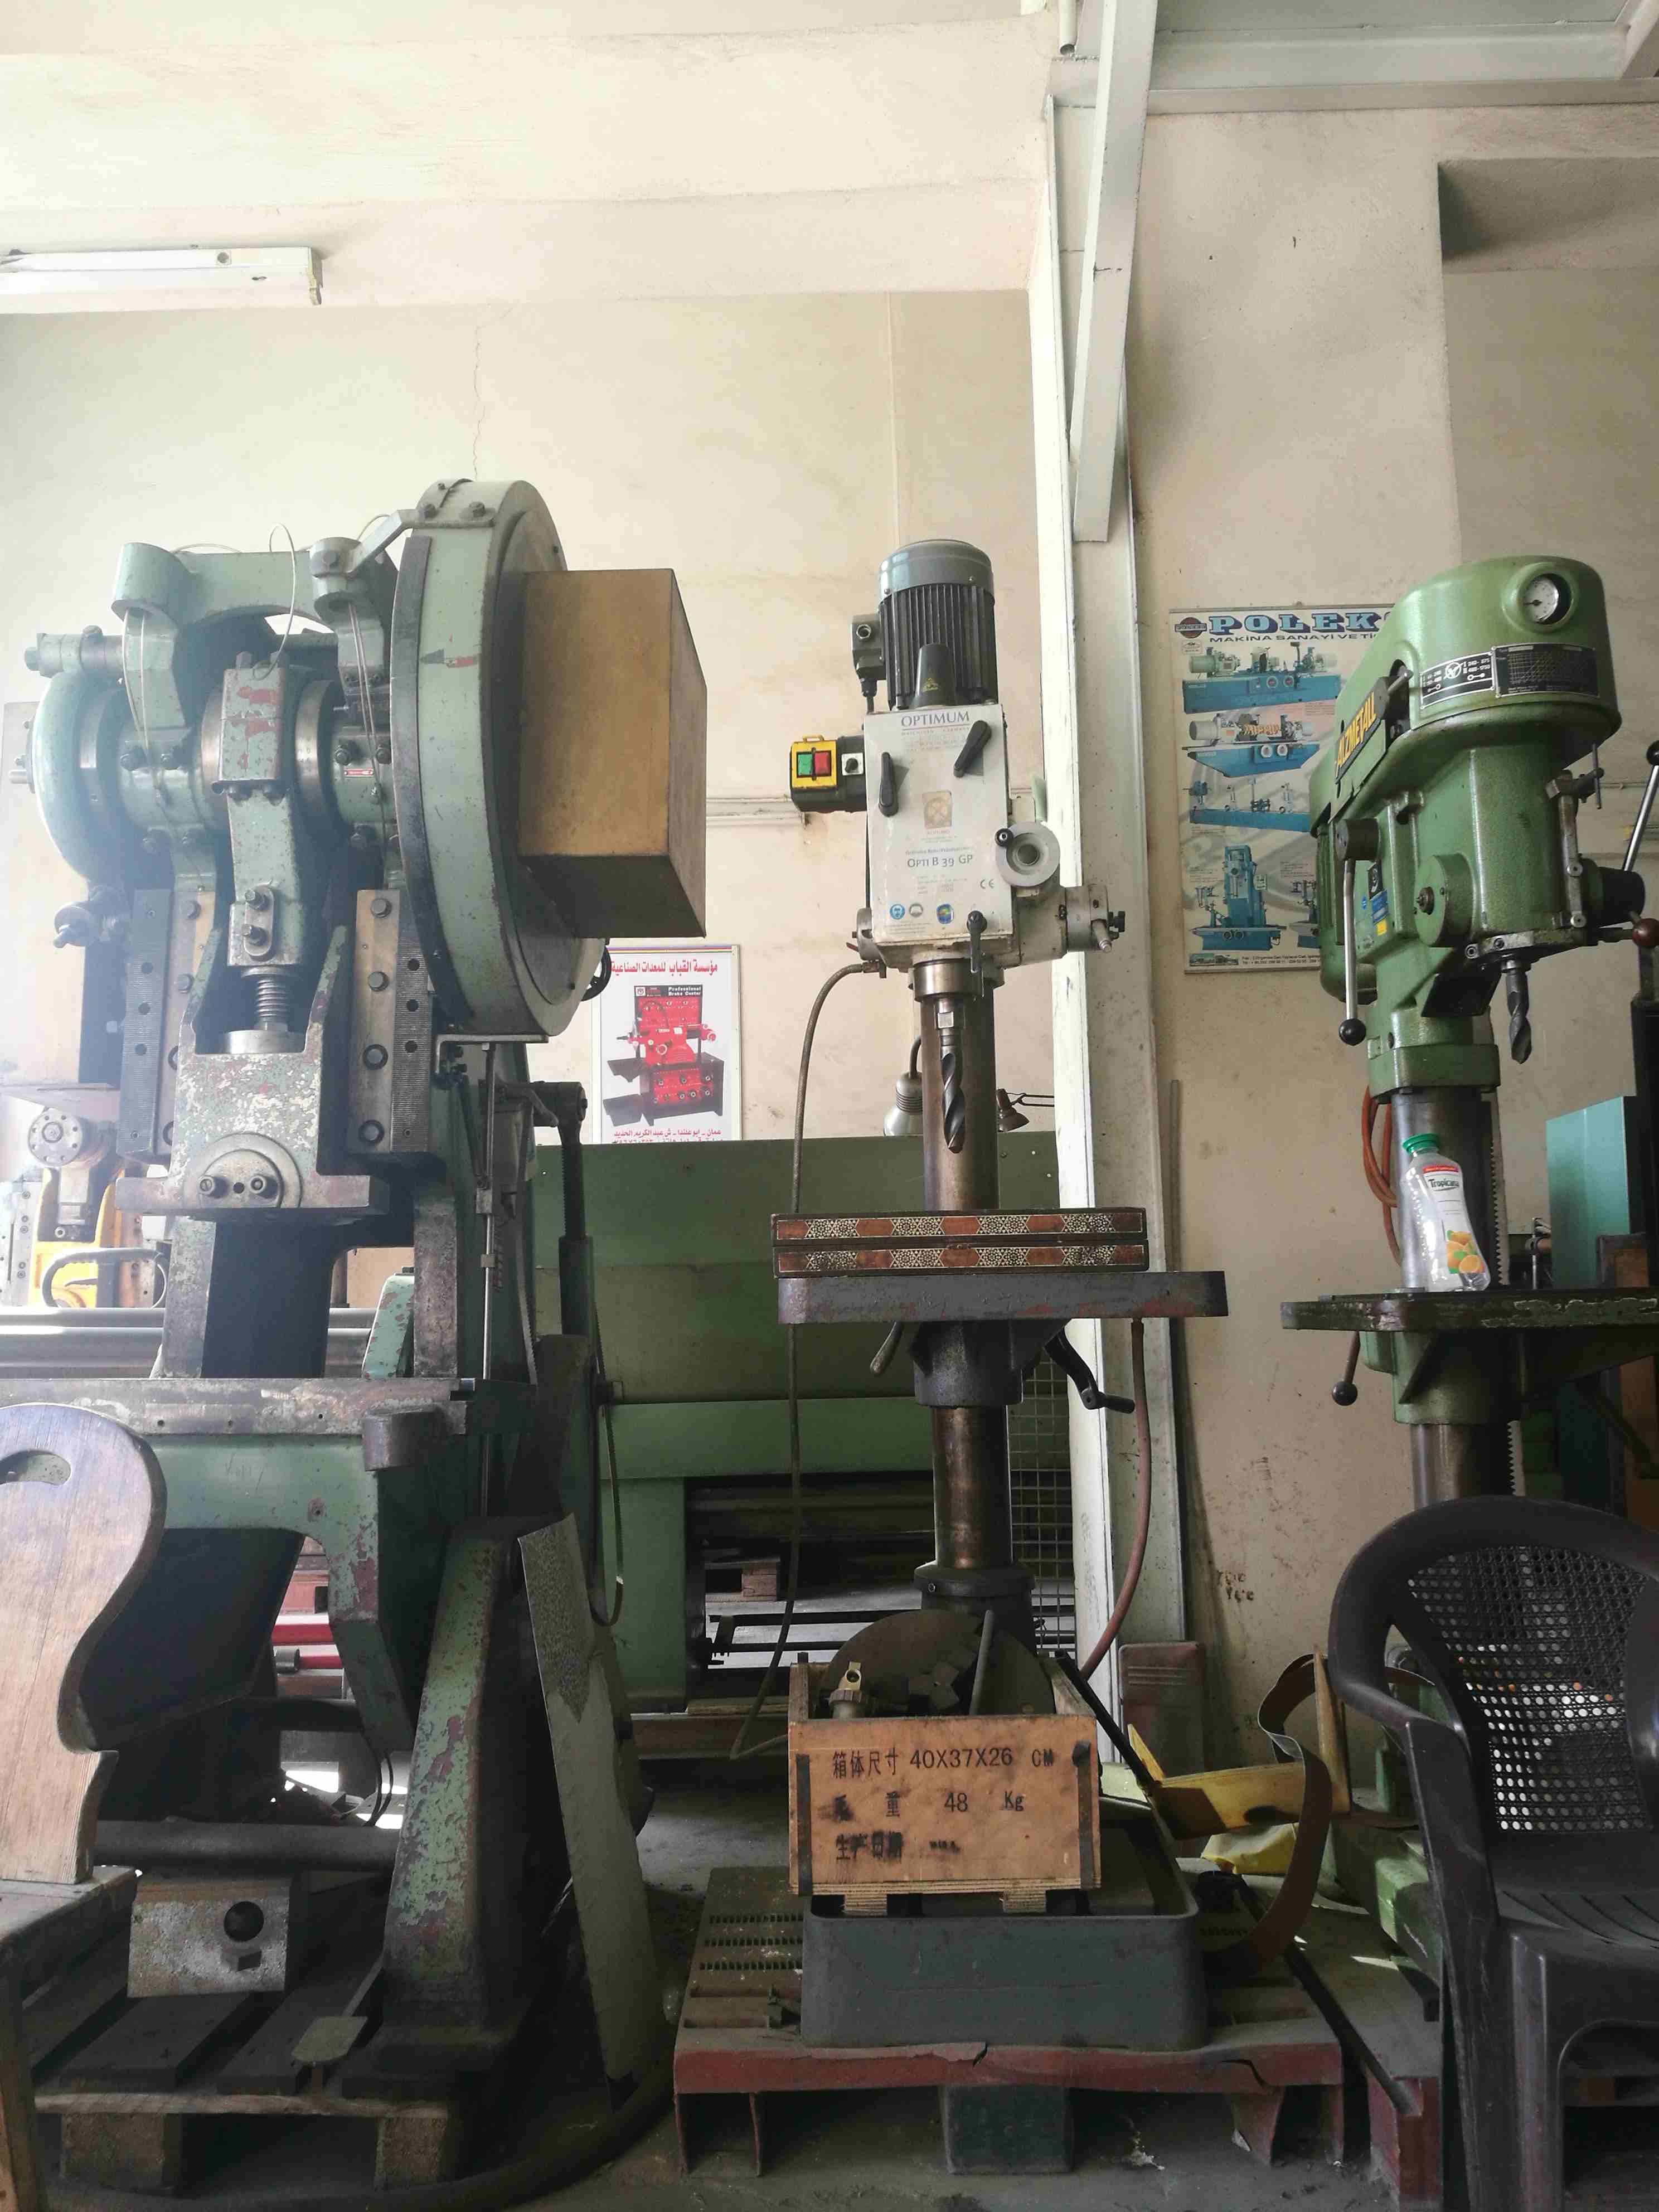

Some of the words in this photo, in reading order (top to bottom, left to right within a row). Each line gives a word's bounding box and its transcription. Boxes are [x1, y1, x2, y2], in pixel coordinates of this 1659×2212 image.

[1209, 612, 1390, 636] POLEK
[1209, 634, 1273, 643] MAKİNA
[901, 711, 969, 727] OPTIMUM
[1337, 691, 1377, 768] ALZMETALL
[932, 857, 939, 866] B
[941, 858, 955, 867] 39
[958, 854, 973, 864] GP
[641, 961, 666, 972] للمعدات
[693, 959, 718, 976] مؤسسة
[1428, 1178, 1459, 1188] Tropicana
[832, 1747, 899, 1779] 箱体尺寸
[910, 1747, 1013, 1769] 40X37X26
[1032, 1749, 1054, 1767] CM
[944, 1792, 969, 1813] 48
[1003, 1790, 1025, 1812] Kg
